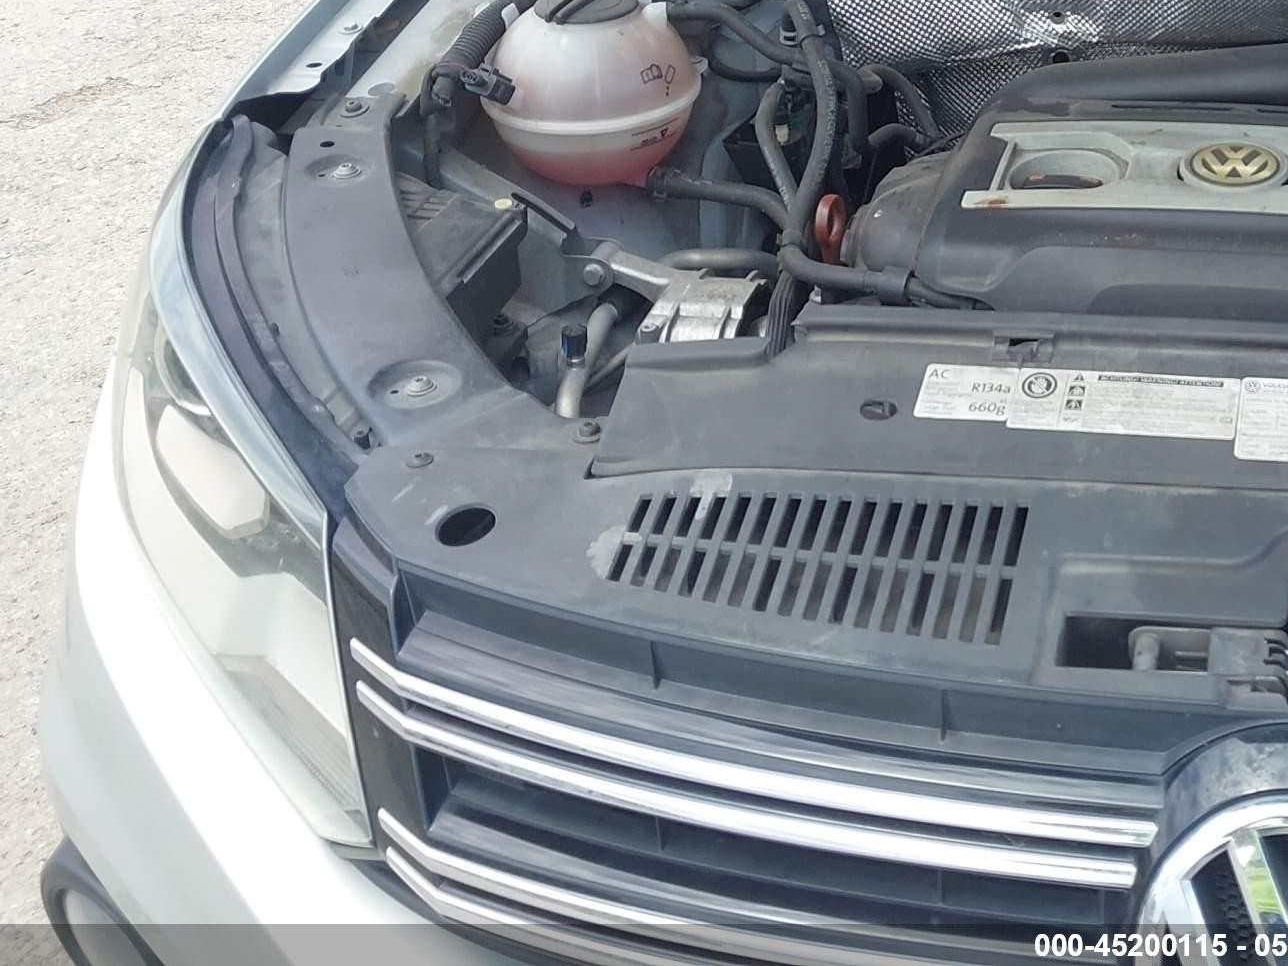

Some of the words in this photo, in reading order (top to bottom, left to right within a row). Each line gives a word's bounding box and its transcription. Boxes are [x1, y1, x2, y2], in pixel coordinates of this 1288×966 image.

[1190, 144, 1281, 187] VW
[928, 368, 951, 379] AC
[971, 382, 1011, 394] R134a
[968, 401, 1006, 416] 660g
